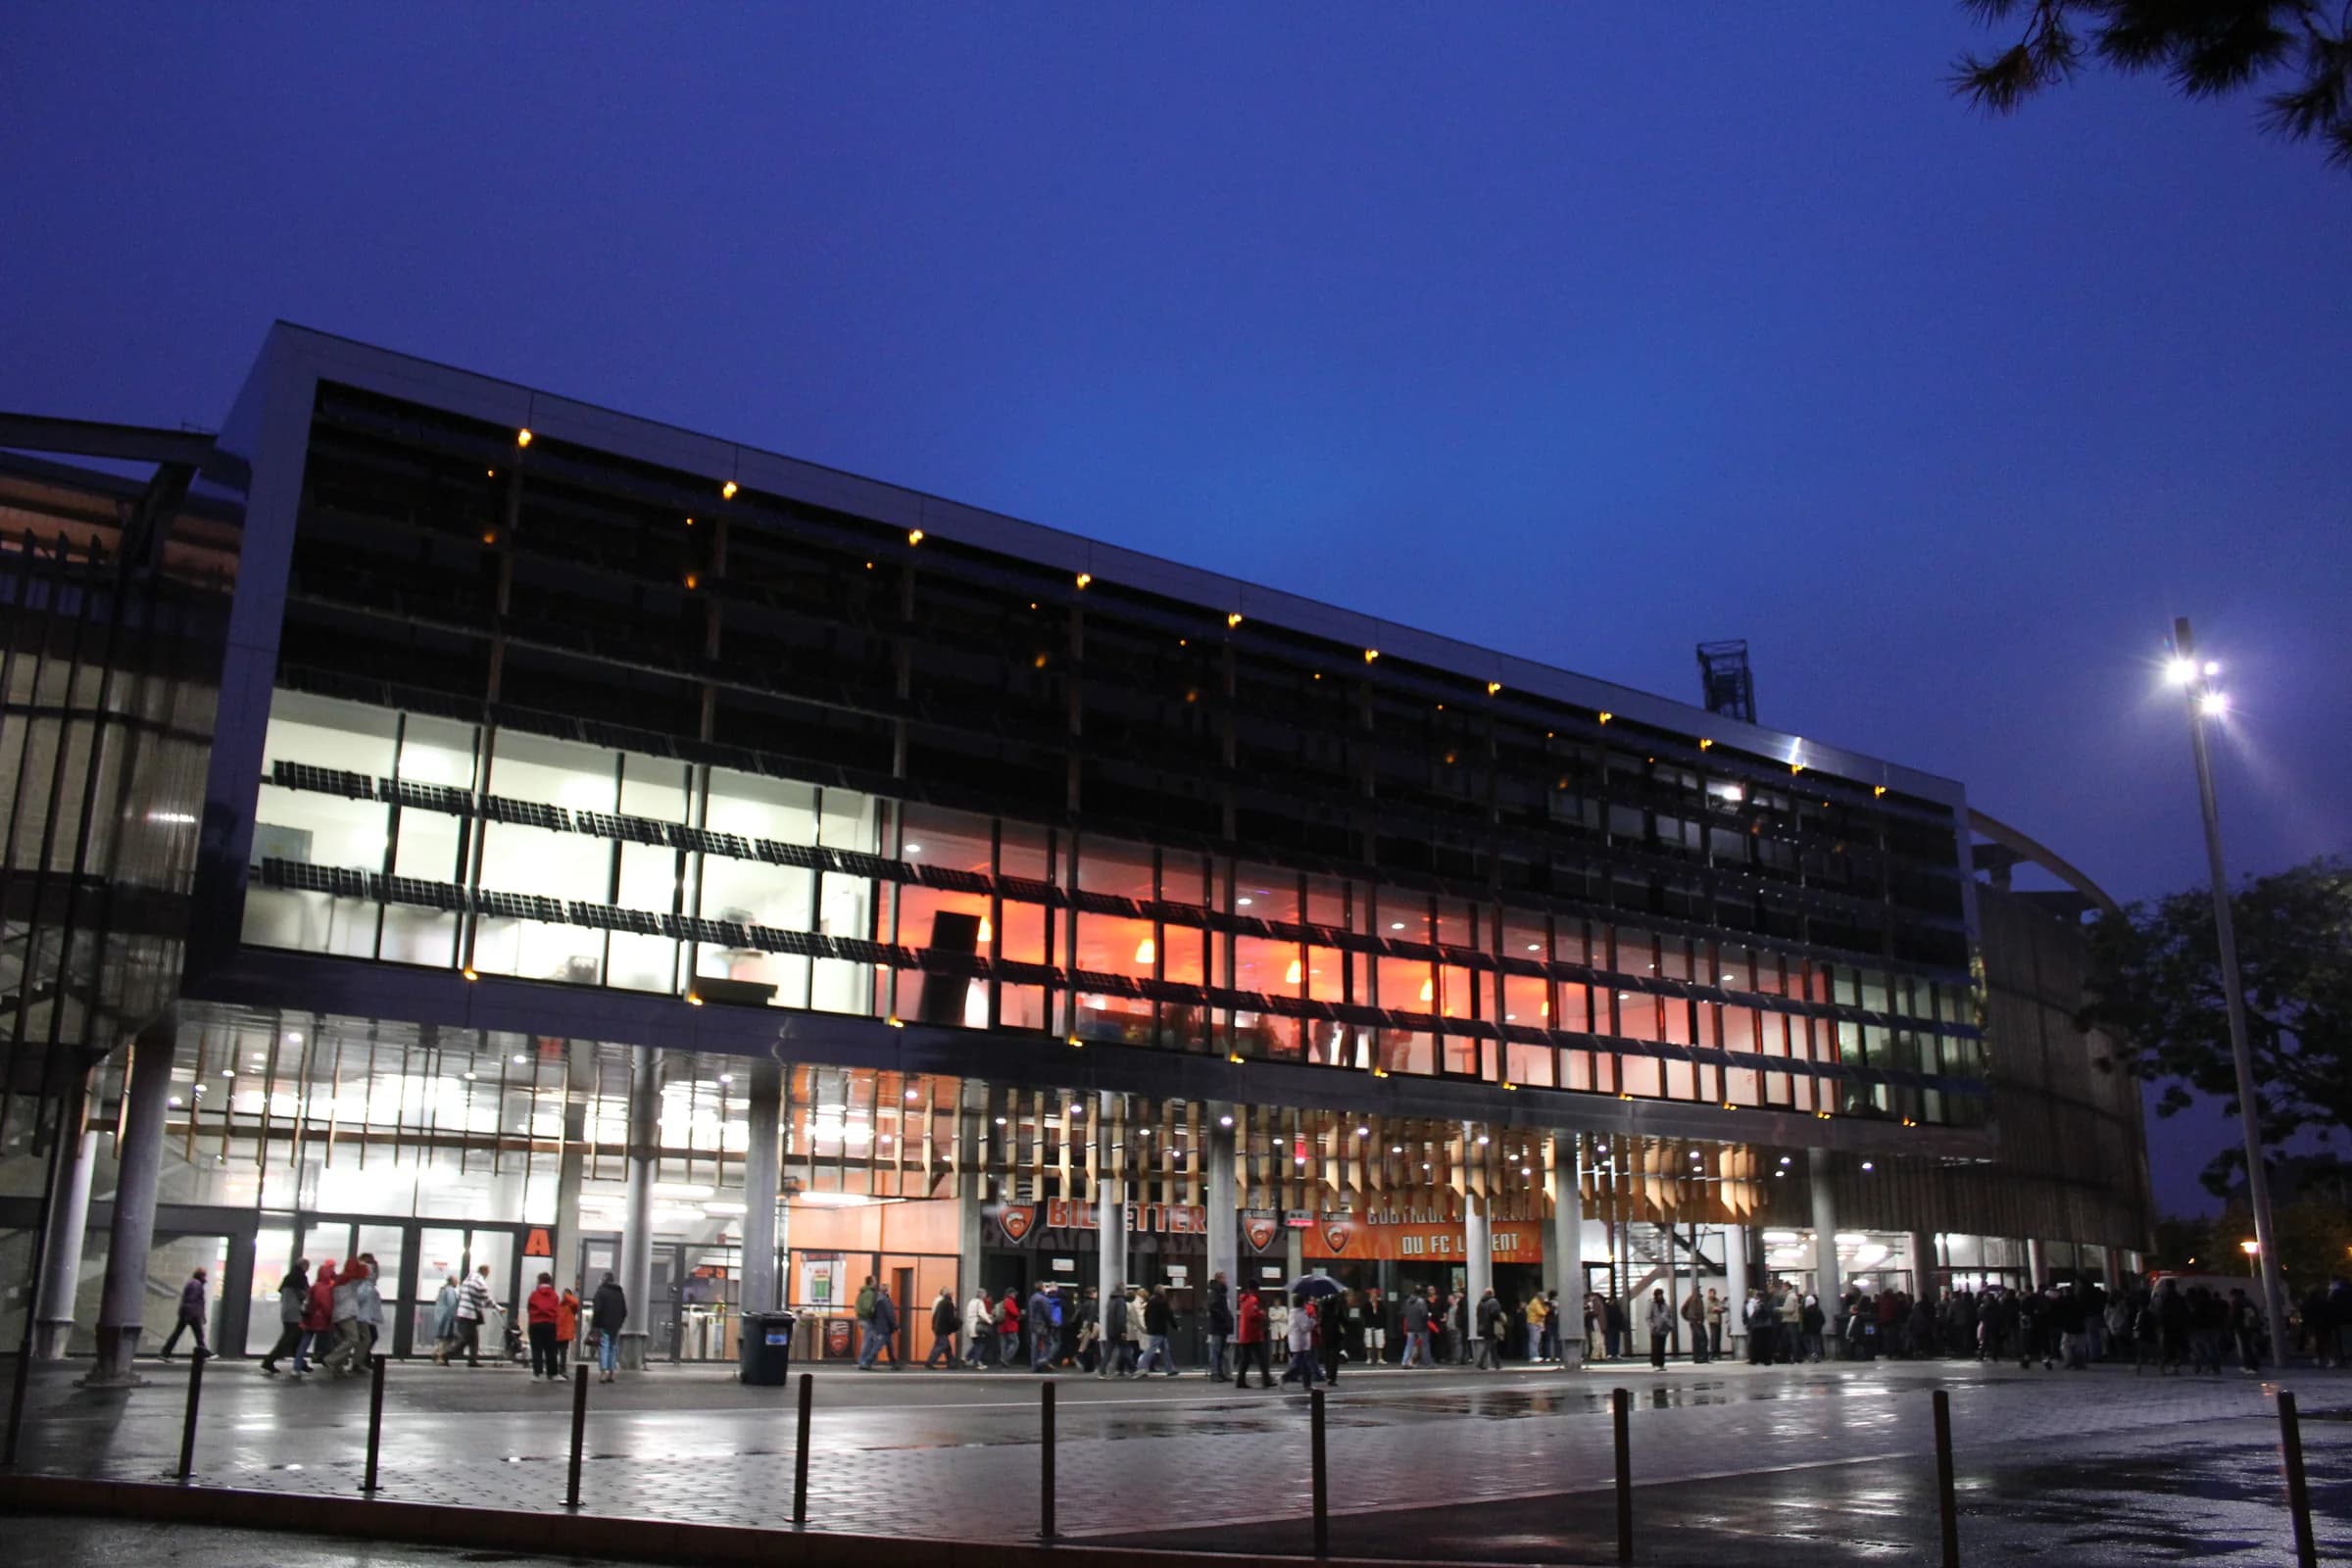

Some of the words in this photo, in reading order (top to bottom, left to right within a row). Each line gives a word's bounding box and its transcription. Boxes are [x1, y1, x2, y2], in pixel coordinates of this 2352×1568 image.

[524, 1229, 551, 1255] A
[1402, 1236, 1424, 1255] DU
[1431, 1235, 1450, 1254] FC
